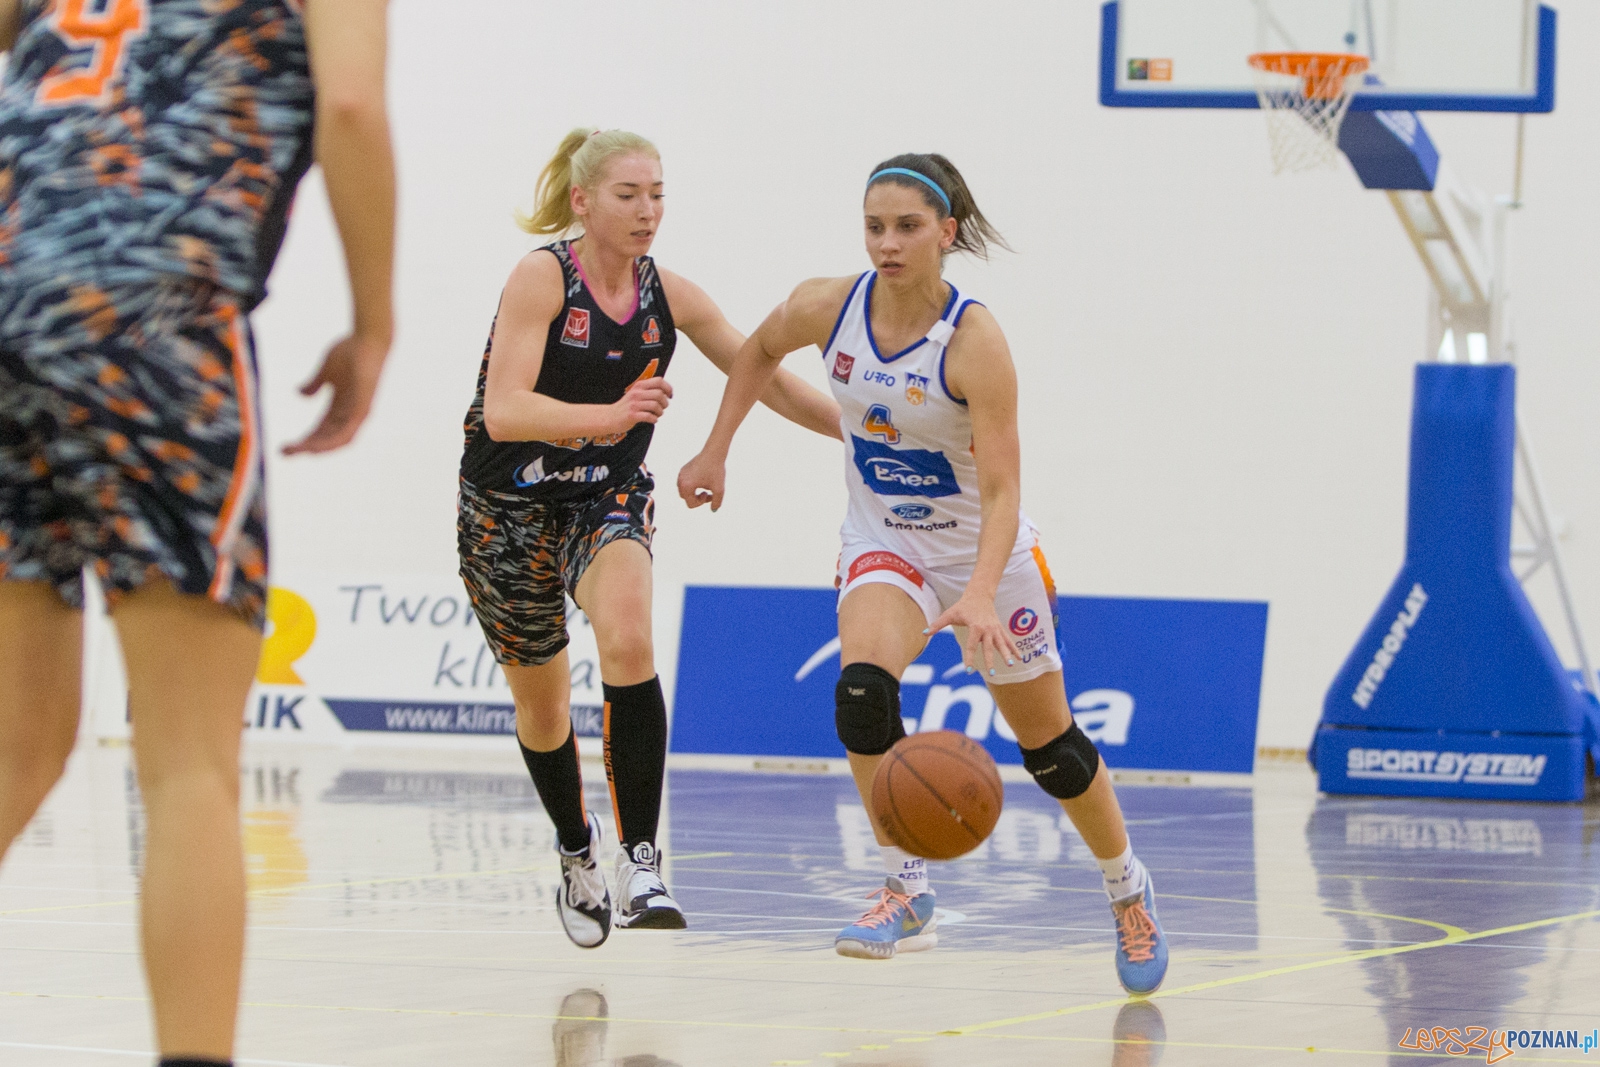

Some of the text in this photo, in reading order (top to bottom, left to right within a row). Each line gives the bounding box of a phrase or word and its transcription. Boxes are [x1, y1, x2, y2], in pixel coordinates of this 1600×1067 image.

[862, 404, 900, 444] 4
[898, 507, 926, 518] Ford
[1352, 582, 1428, 709] HYDROPLAY
